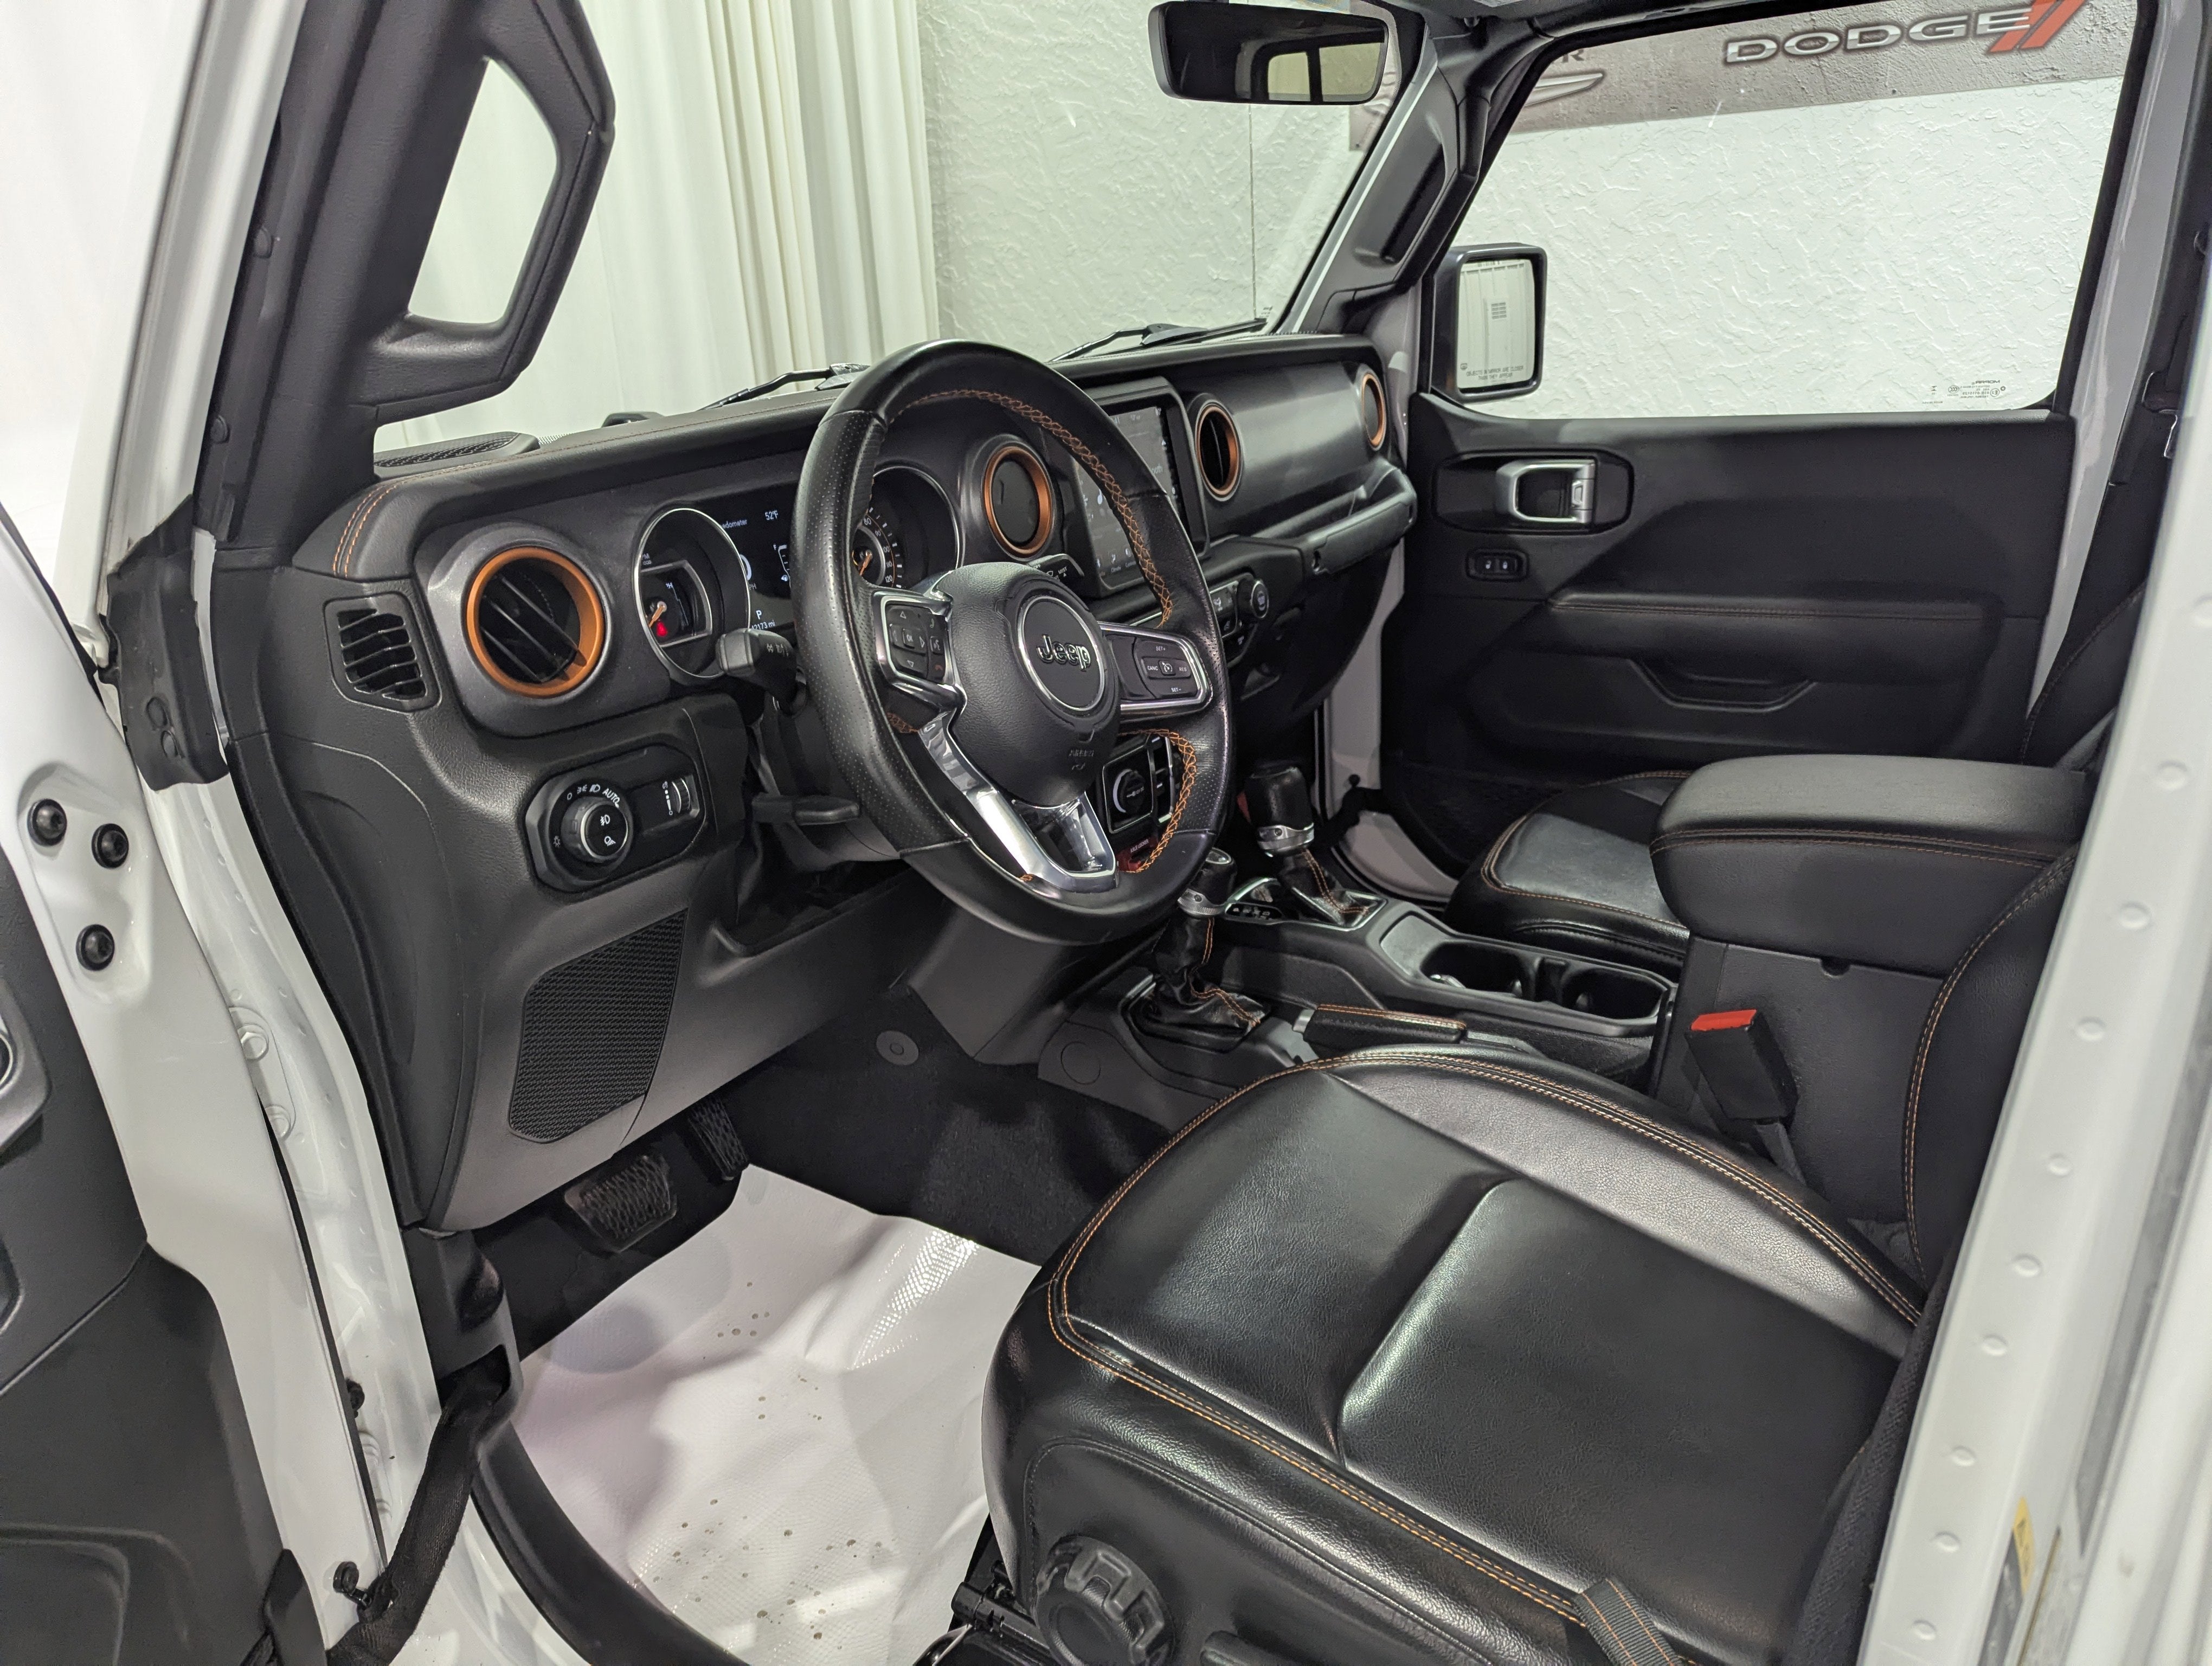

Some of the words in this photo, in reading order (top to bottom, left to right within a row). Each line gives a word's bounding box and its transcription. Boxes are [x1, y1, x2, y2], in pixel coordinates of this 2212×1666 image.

[1725, 7, 2031, 63] DODGE
[721, 519, 747, 529] edometer
[863, 517, 872, 526] 80
[756, 610, 762, 620] P
[768, 619, 776, 628] mi
[1036, 633, 1091, 672] Jeep
[602, 788, 620, 804] AUTO
